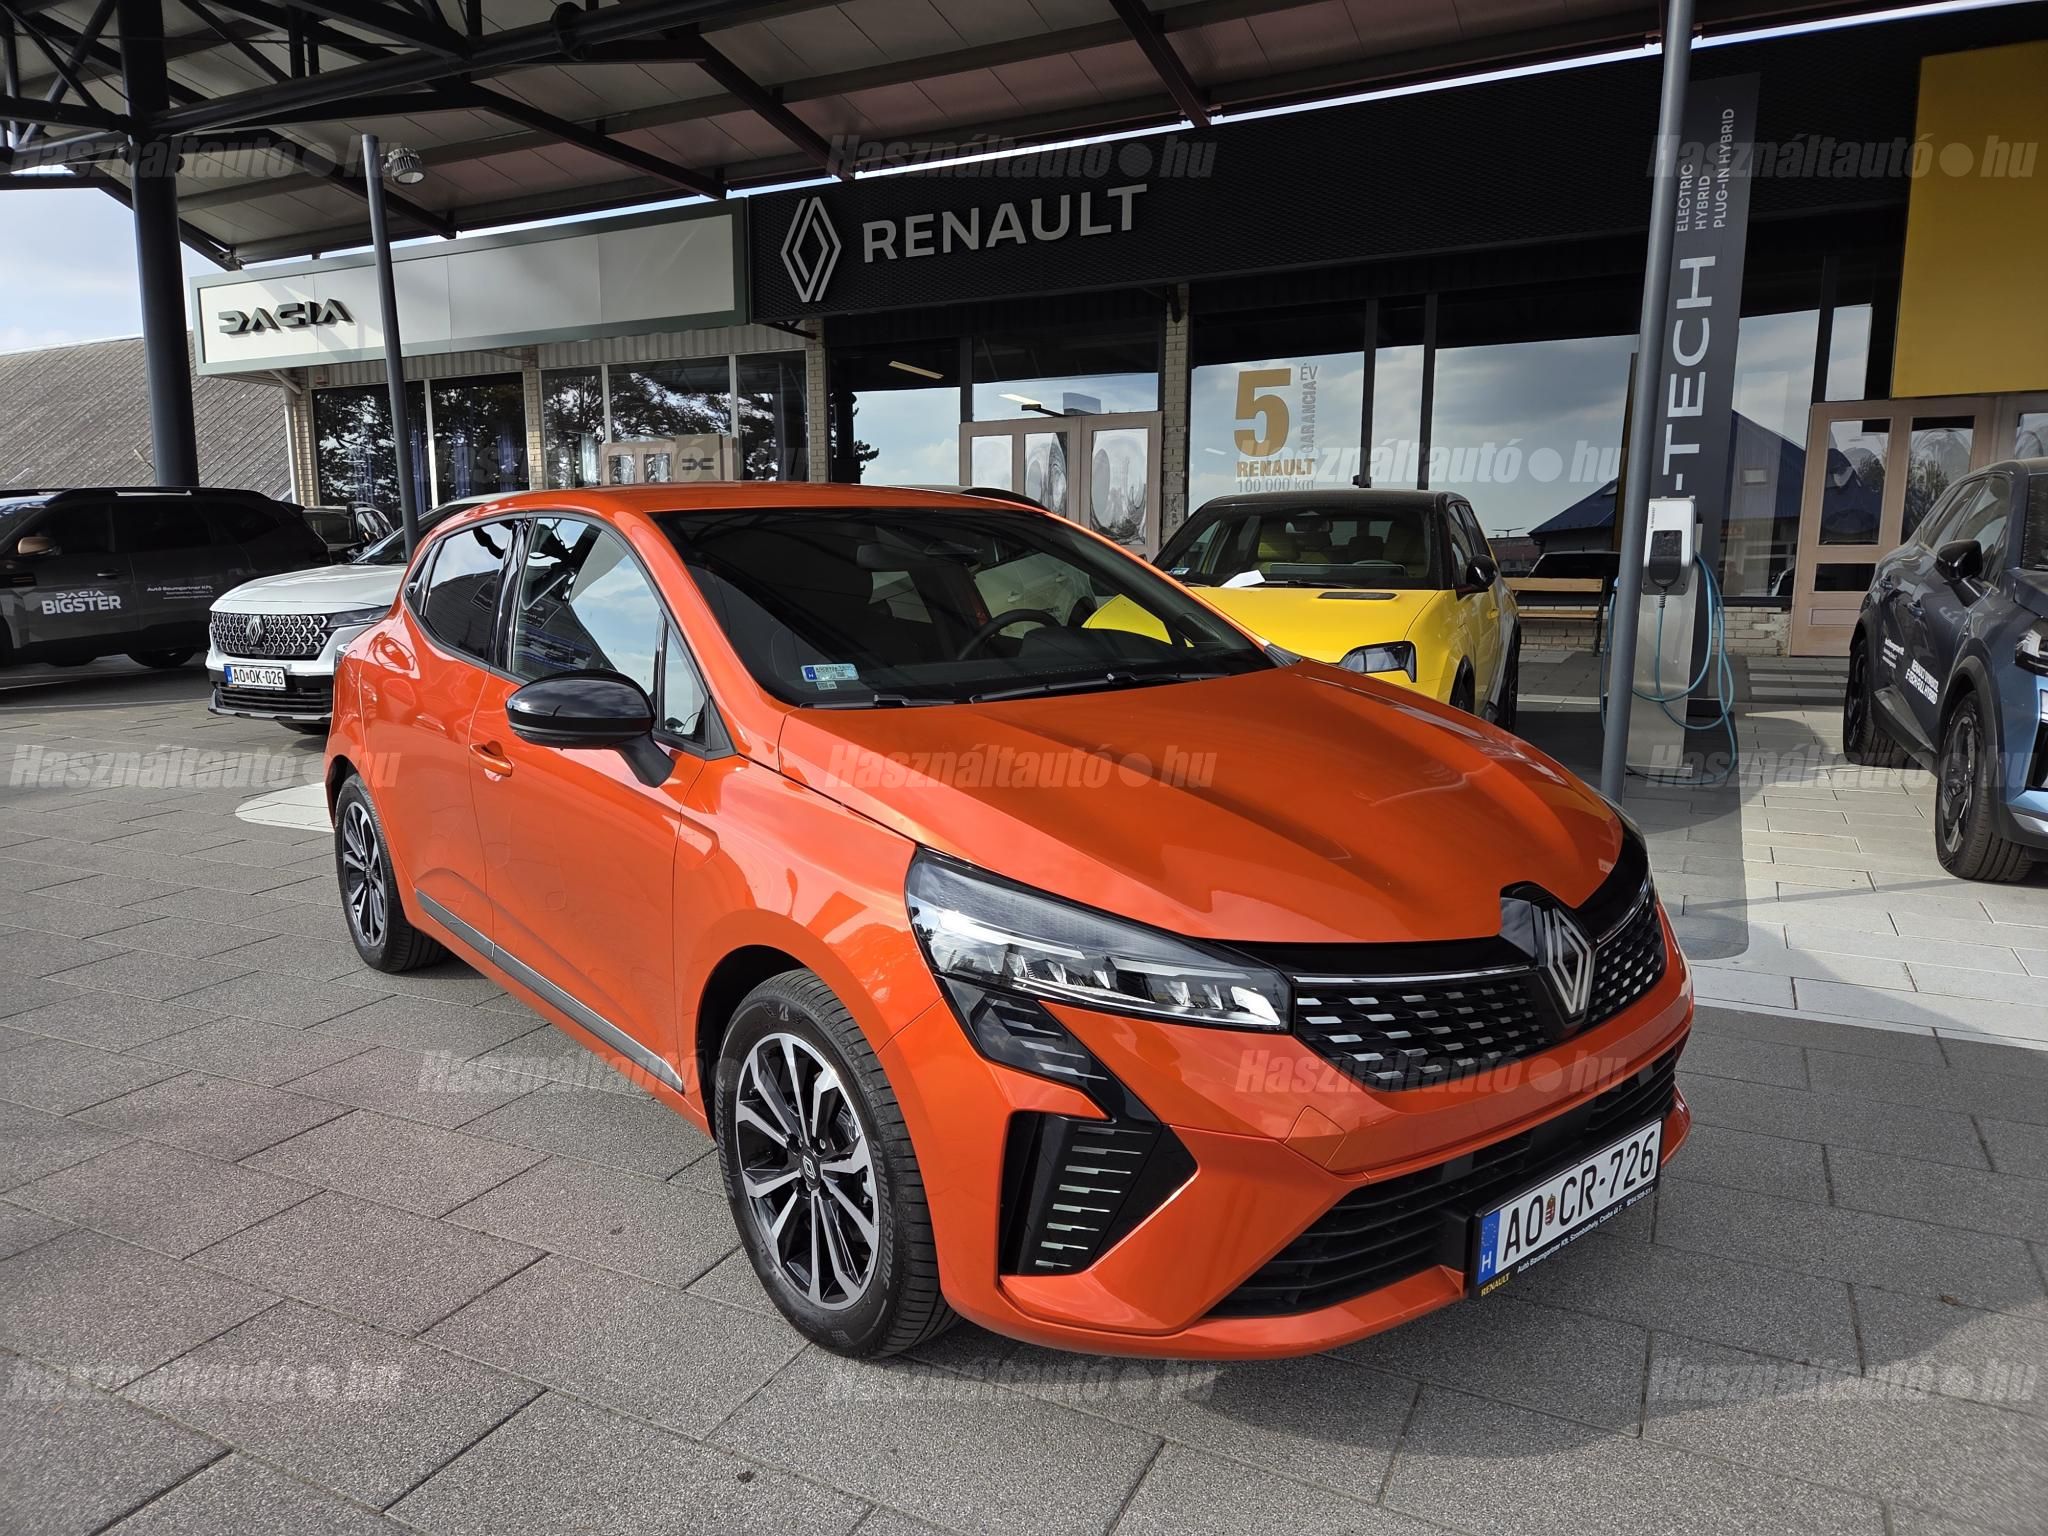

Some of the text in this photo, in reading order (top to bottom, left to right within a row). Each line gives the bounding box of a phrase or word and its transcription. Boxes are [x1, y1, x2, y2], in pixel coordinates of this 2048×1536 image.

[1713, 108, 1734, 228] PLUG-IN HYBRID
[862, 183, 1148, 263] RENAULT
[1676, 163, 1693, 232] ELECTRIC
[1695, 175, 1710, 230] HYBRID
[218, 298, 352, 335] DACIA
[1662, 255, 1716, 491] -TECH
[1233, 363, 1318, 457] 5 ÉV
[1301, 380, 1317, 453] GARANCIA
[1236, 458, 1315, 477] RENAULT
[1238, 478, 1314, 493] 100 000 km
[42, 595, 122, 615] BIGSTER
[56, 591, 105, 599] DACIA
[1503, 1130, 1656, 1262] AO CR-726
[1480, 1272, 1511, 1297] RENAULT
[1481, 1251, 1493, 1273] H
